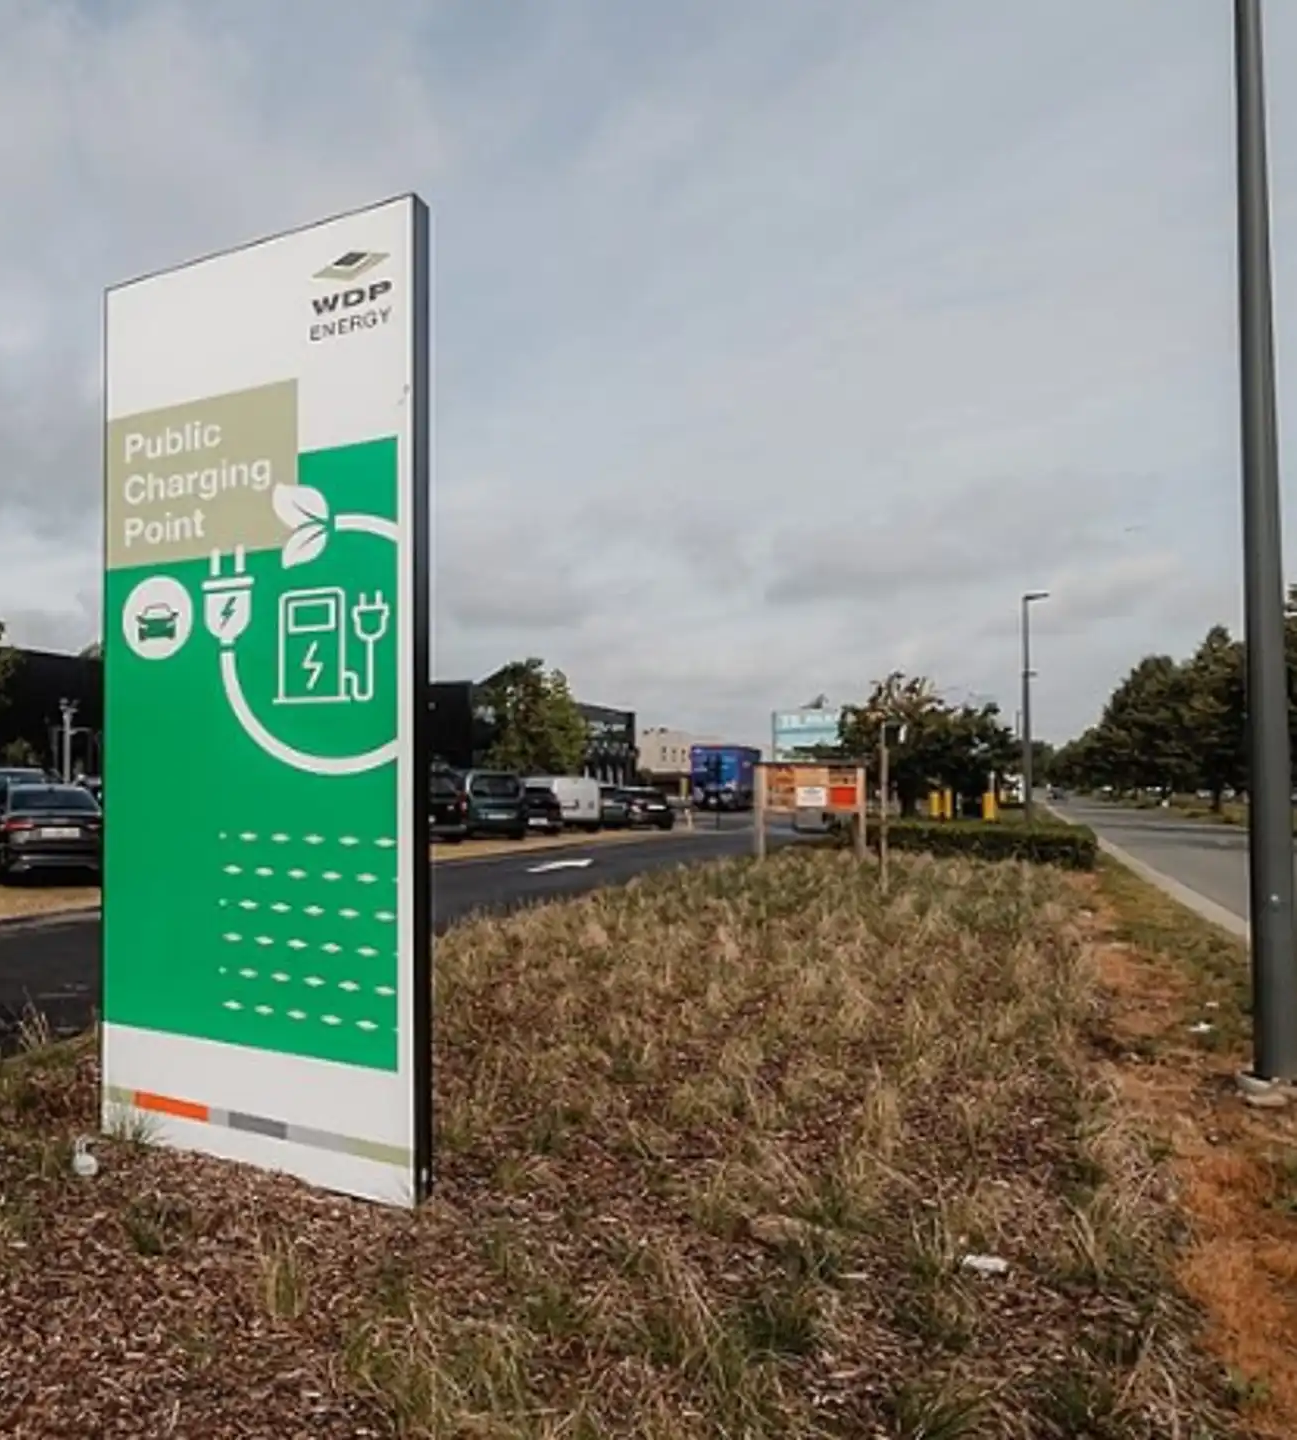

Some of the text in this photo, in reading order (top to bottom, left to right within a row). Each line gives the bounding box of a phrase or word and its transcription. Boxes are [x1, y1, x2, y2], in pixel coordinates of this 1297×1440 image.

[312, 280, 392, 316] WDP
[309, 305, 392, 341] ENERGY
[124, 421, 222, 464] Public
[124, 458, 271, 505] Charging
[124, 508, 206, 547] Point
